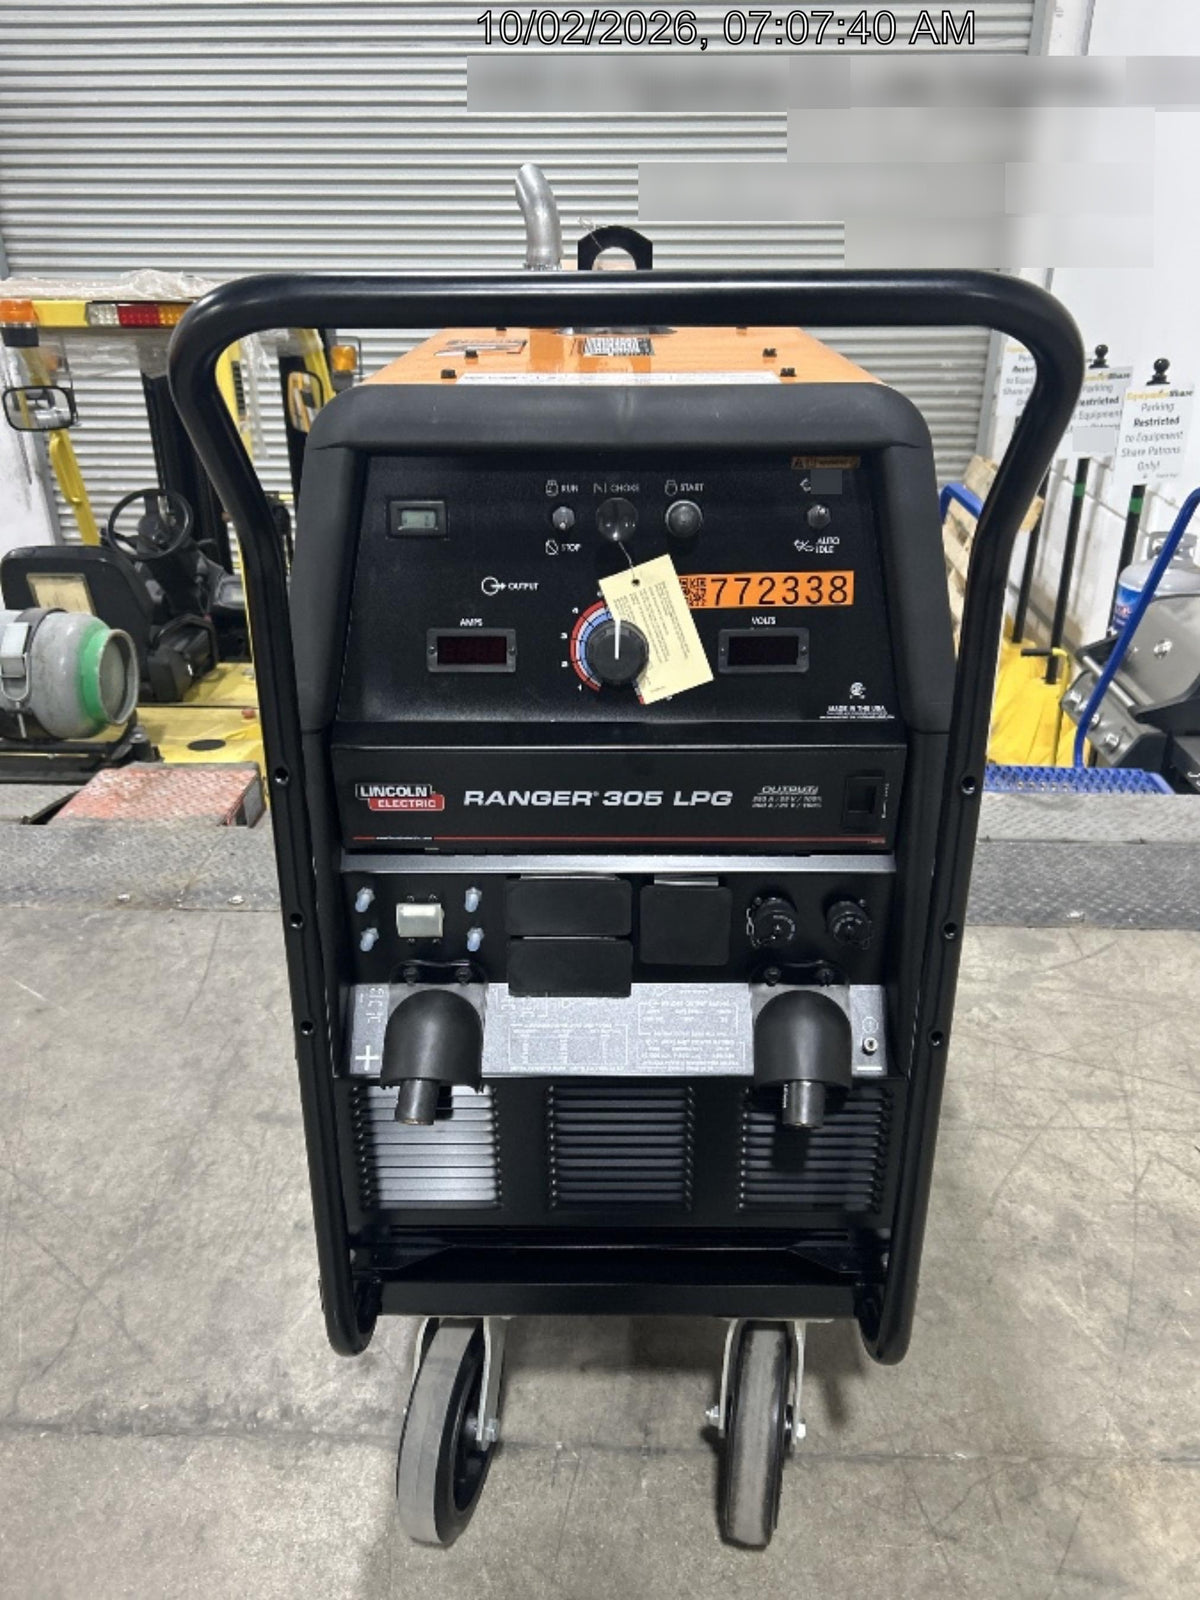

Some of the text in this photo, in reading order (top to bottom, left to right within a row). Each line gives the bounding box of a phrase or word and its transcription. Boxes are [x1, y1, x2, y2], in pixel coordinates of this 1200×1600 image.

[1141, 403, 1175, 412] Parking
[1133, 416, 1180, 427] Restricted
[1121, 446, 1181, 457] Share Patrons
[561, 484, 579, 493] RUN
[680, 483, 704, 492] START
[816, 536, 840, 545] AUTO
[561, 543, 582, 552] STOP
[815, 545, 835, 554] IDLE
[508, 582, 539, 591] OUTPUT
[711, 575, 847, 606] 772338
[460, 618, 483, 627] AMPS
[752, 616, 776, 625] VOLTS
[360, 786, 428, 798] LINCOLN
[602, 790, 664, 806] 305
[673, 790, 733, 806] LPG
[378, 799, 436, 808] ELECTRIC
